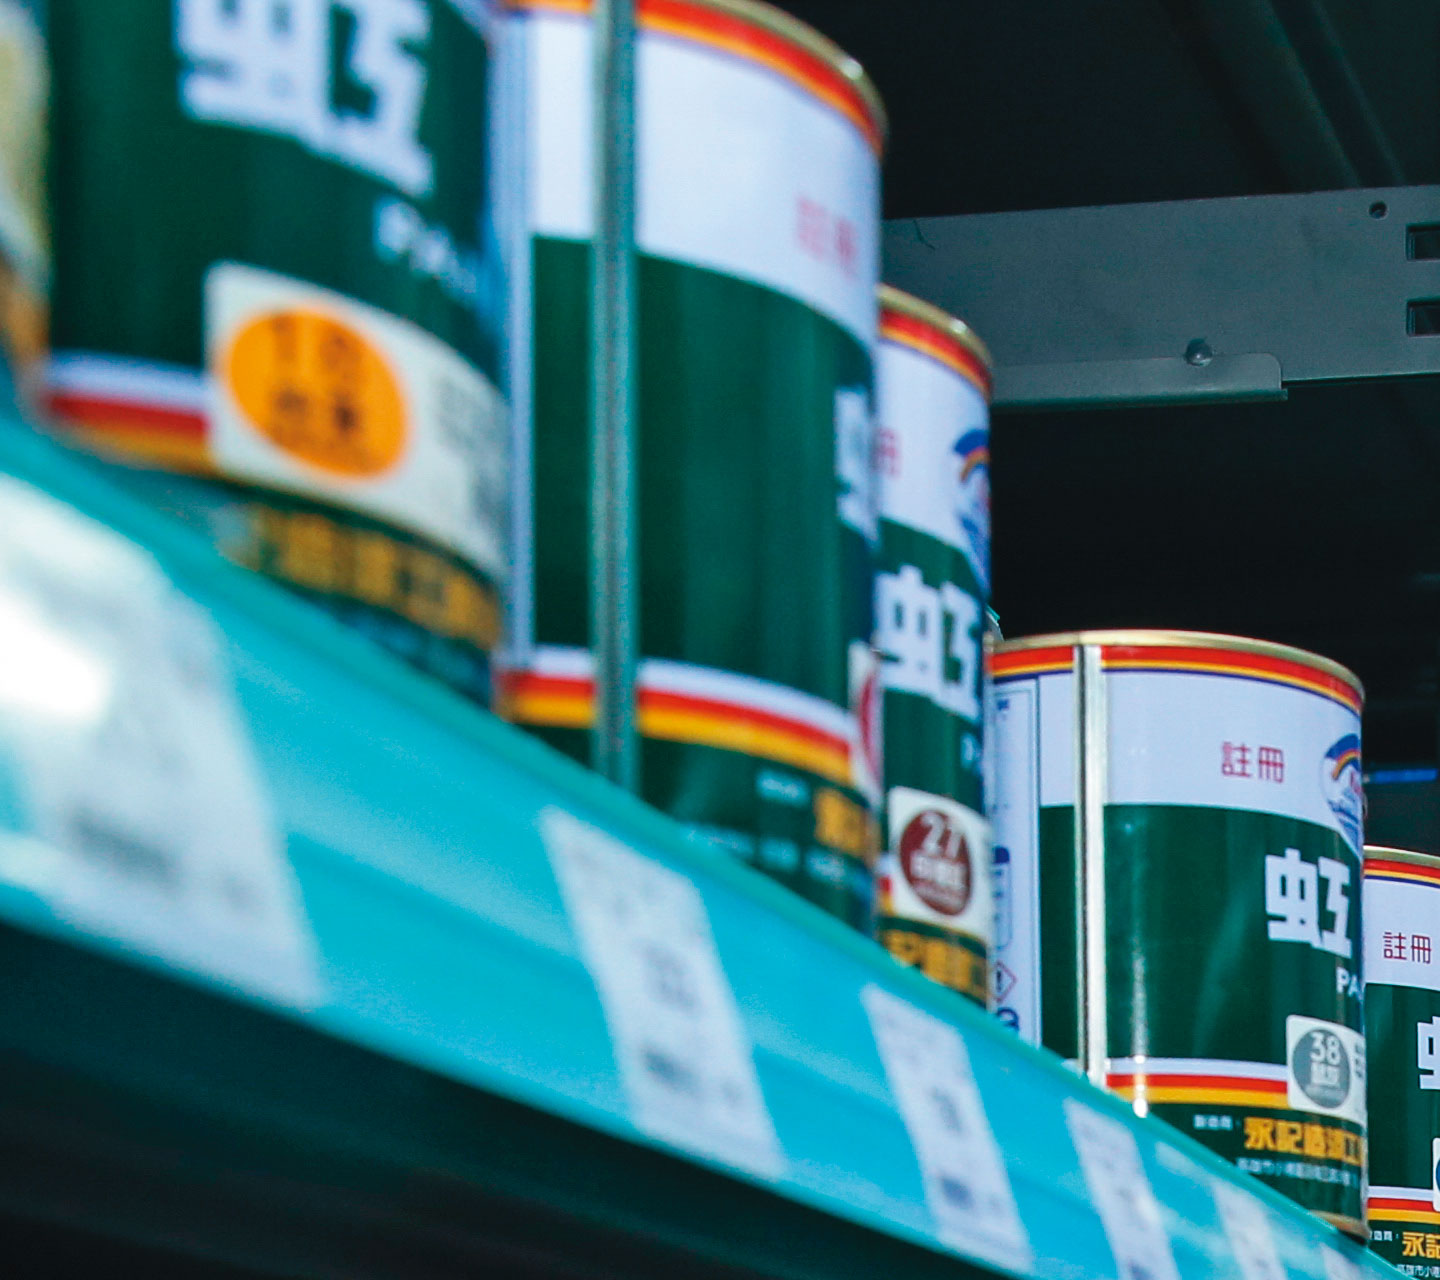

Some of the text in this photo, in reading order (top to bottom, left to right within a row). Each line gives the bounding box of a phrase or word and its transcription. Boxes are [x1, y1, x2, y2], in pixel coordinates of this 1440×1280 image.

[1221, 742, 1285, 784] 註冊
[1383, 931, 1432, 964] 註冊
[1310, 1030, 1340, 1066] 38
